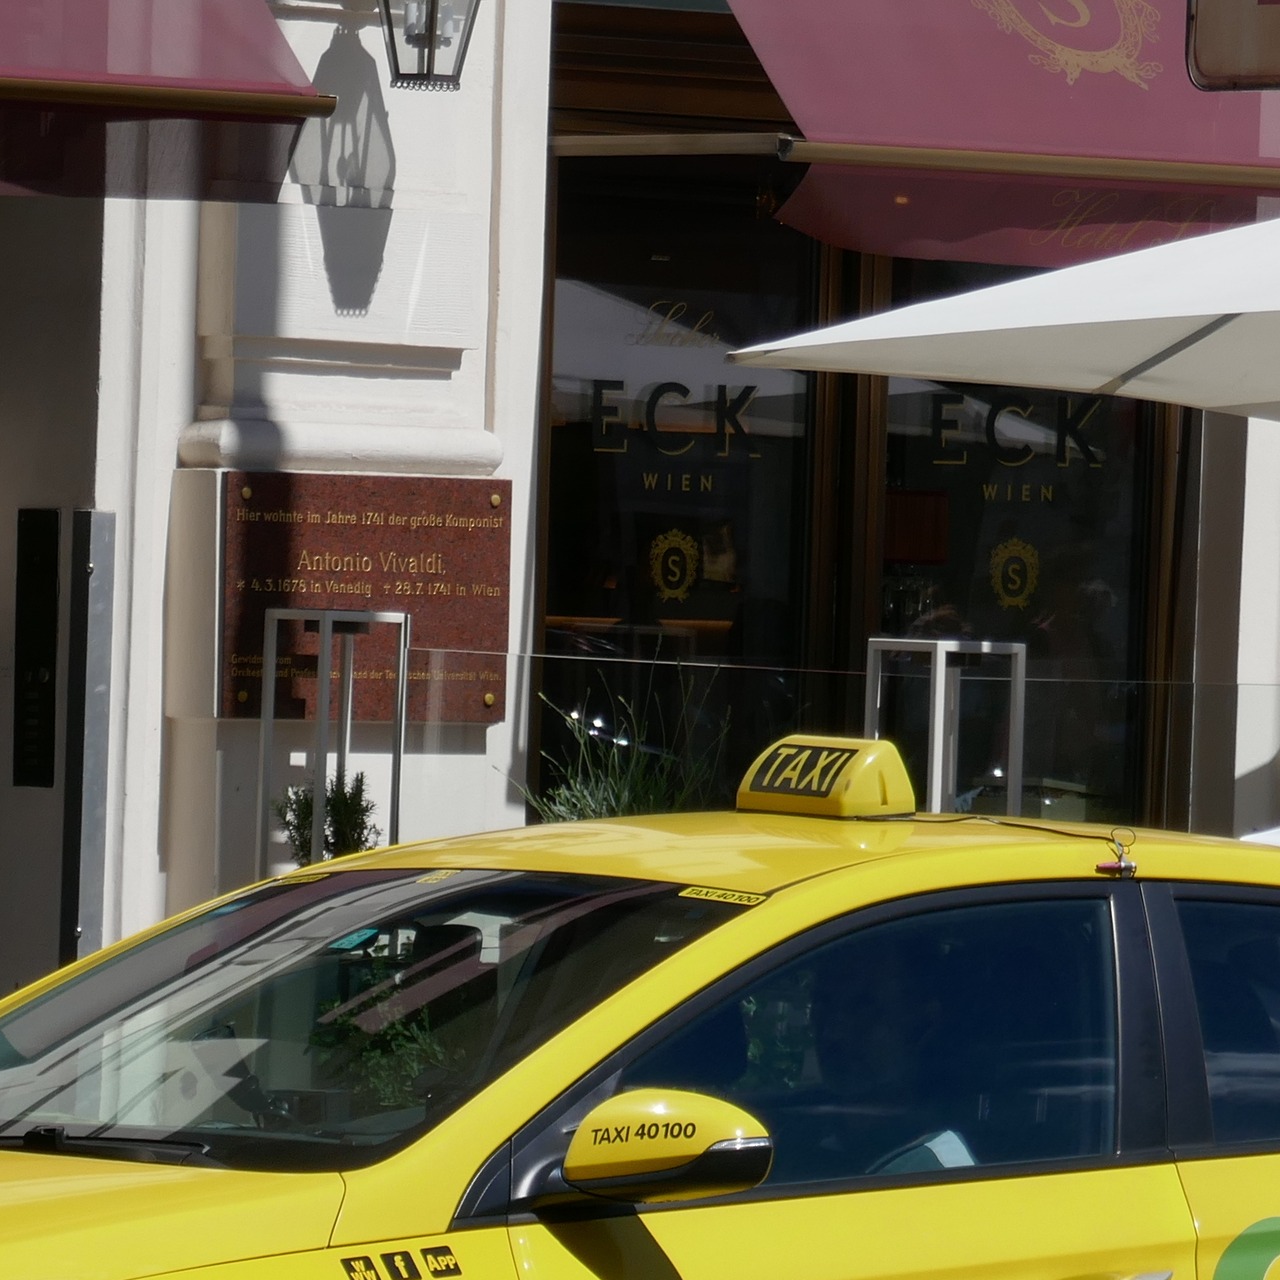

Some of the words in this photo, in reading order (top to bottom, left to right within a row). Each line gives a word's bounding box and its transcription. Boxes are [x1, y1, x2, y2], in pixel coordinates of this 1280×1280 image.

[591, 379, 761, 458] ECK
[931, 392, 1105, 468] ECK
[643, 471, 713, 492] WIEN
[983, 483, 1054, 502] WIEN
[236, 509, 261, 521] Hier
[263, 510, 303, 523] wohnte
[307, 511, 321, 523] im
[323, 511, 357, 524] Jahre
[361, 512, 384, 525] 1741
[388, 514, 407, 526] der
[410, 513, 443, 529] große
[445, 514, 503, 531] Komponist
[297, 550, 371, 572] Antonio
[379, 551, 446, 575] Vivaldi,
[667, 554, 681, 583] S
[310, 579, 321, 593] in
[325, 580, 371, 597] Venedig
[456, 584, 466, 595] in
[472, 584, 501, 596] Wien
[1007, 563, 1021, 590] S
[762, 748, 852, 792] TAXI
[686, 889, 720, 898] TAXI
[591, 1125, 630, 1146] TAXI
[634, 1122, 697, 1140] 40100
